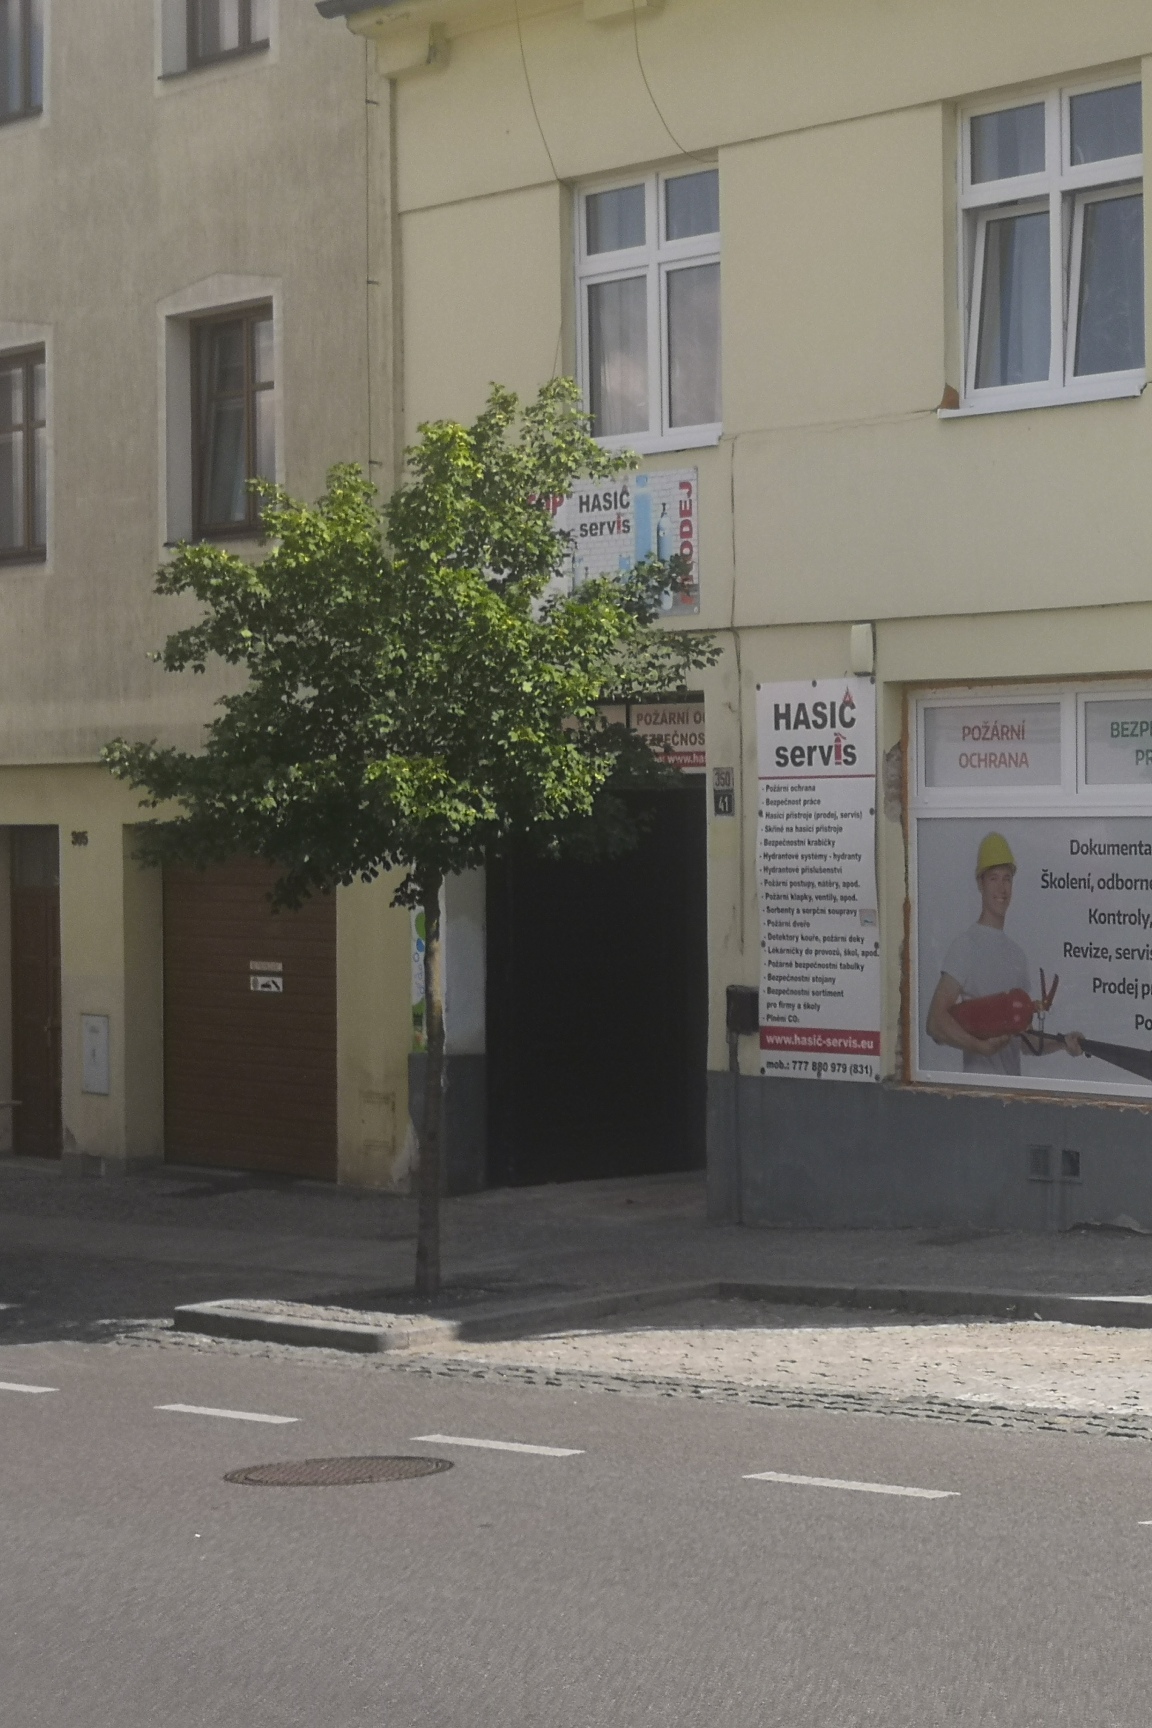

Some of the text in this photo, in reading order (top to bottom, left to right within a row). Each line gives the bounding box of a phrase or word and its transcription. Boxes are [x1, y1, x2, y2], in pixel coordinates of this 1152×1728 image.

[580, 513, 631, 537] servis
[961, 720, 1025, 741] POŽÁRNÍ
[775, 732, 857, 767] servis
[958, 752, 1029, 769] OCHRANA
[1041, 869, 1094, 892] Školení,
[1088, 908, 1152, 930] Kontroly,
[805, 947, 813, 955] do
[1063, 942, 1112, 962] Revize,
[1092, 977, 1138, 999] Prodej
[792, 1060, 809, 1071] 777
[830, 1062, 847, 1073] 979
[849, 1064, 873, 1077] (831)
